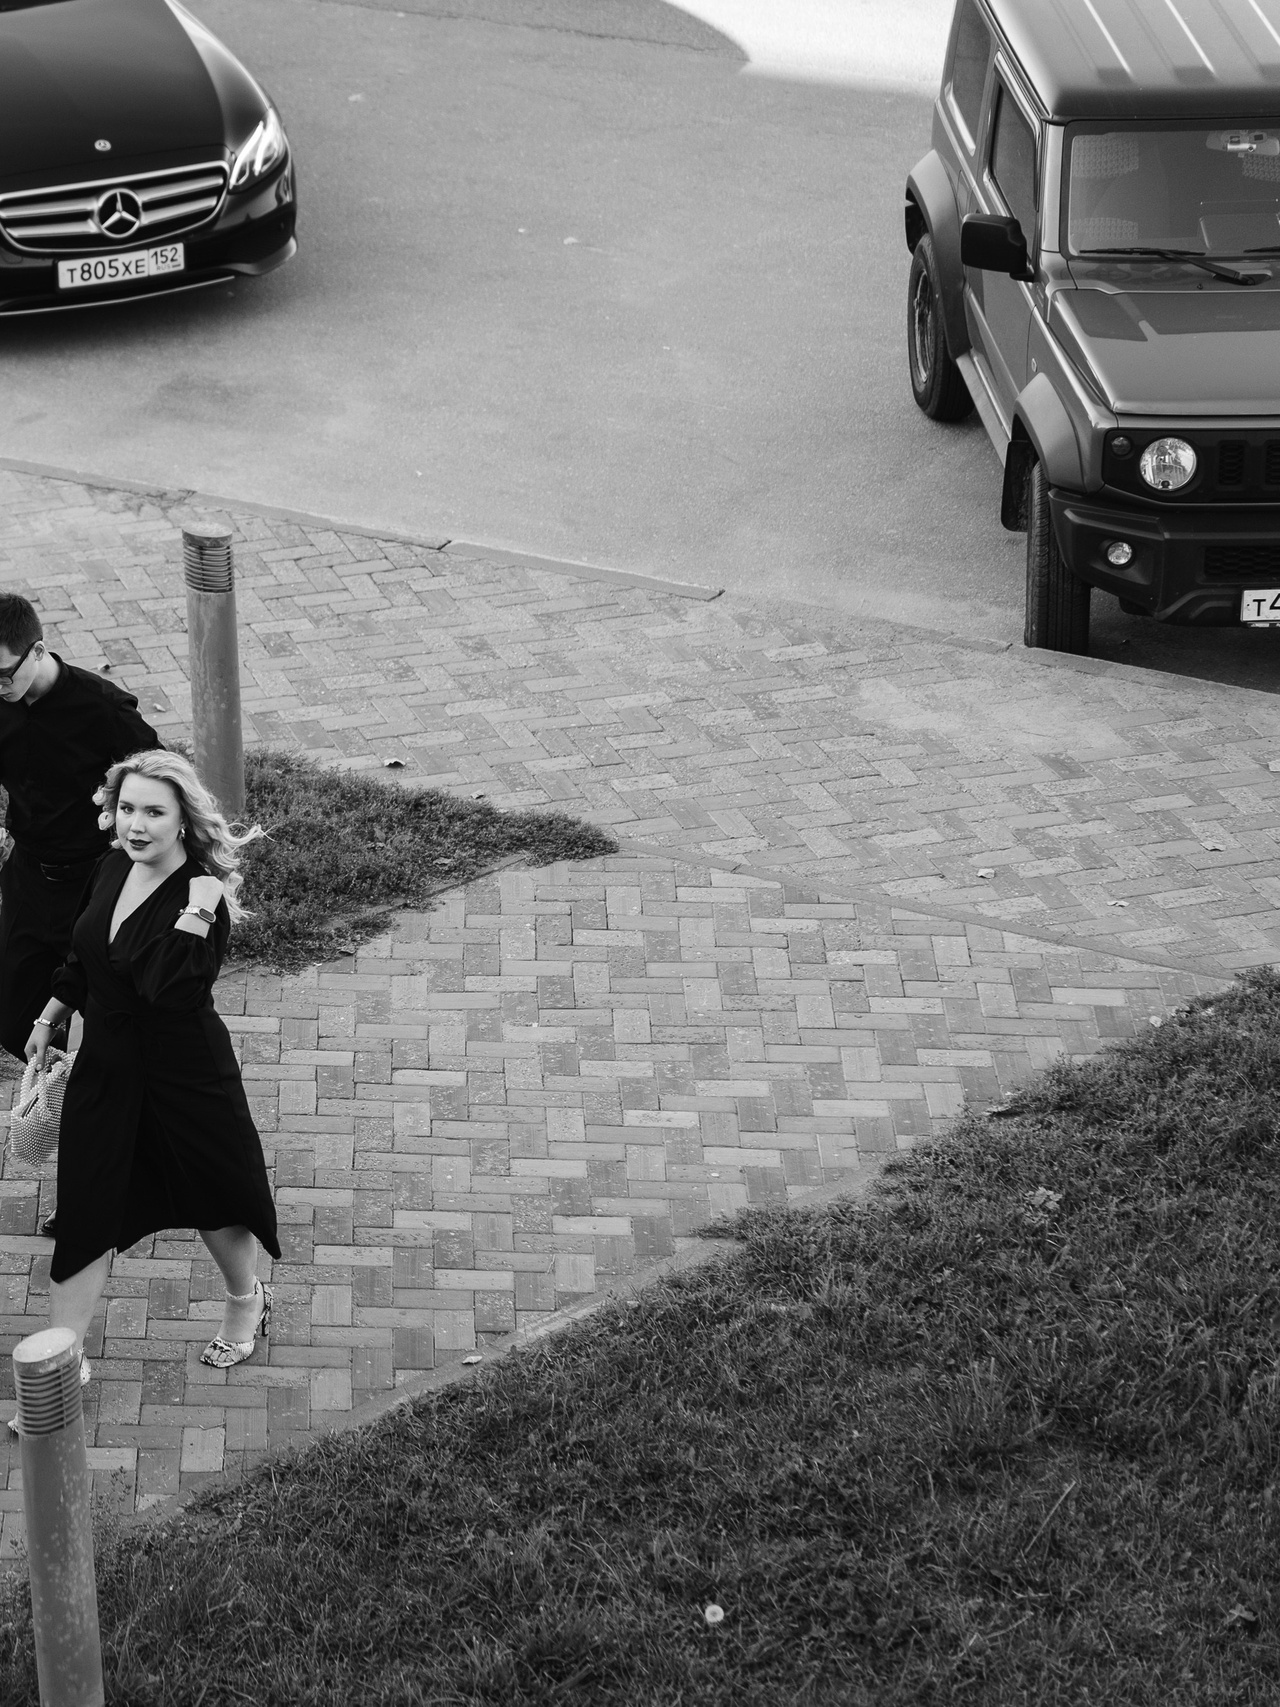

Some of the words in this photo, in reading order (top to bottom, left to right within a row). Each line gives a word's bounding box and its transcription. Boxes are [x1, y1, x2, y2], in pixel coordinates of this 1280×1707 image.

[66, 258, 145, 283] T805XE
[151, 246, 178, 265] 152
[156, 263, 171, 271] RUS
